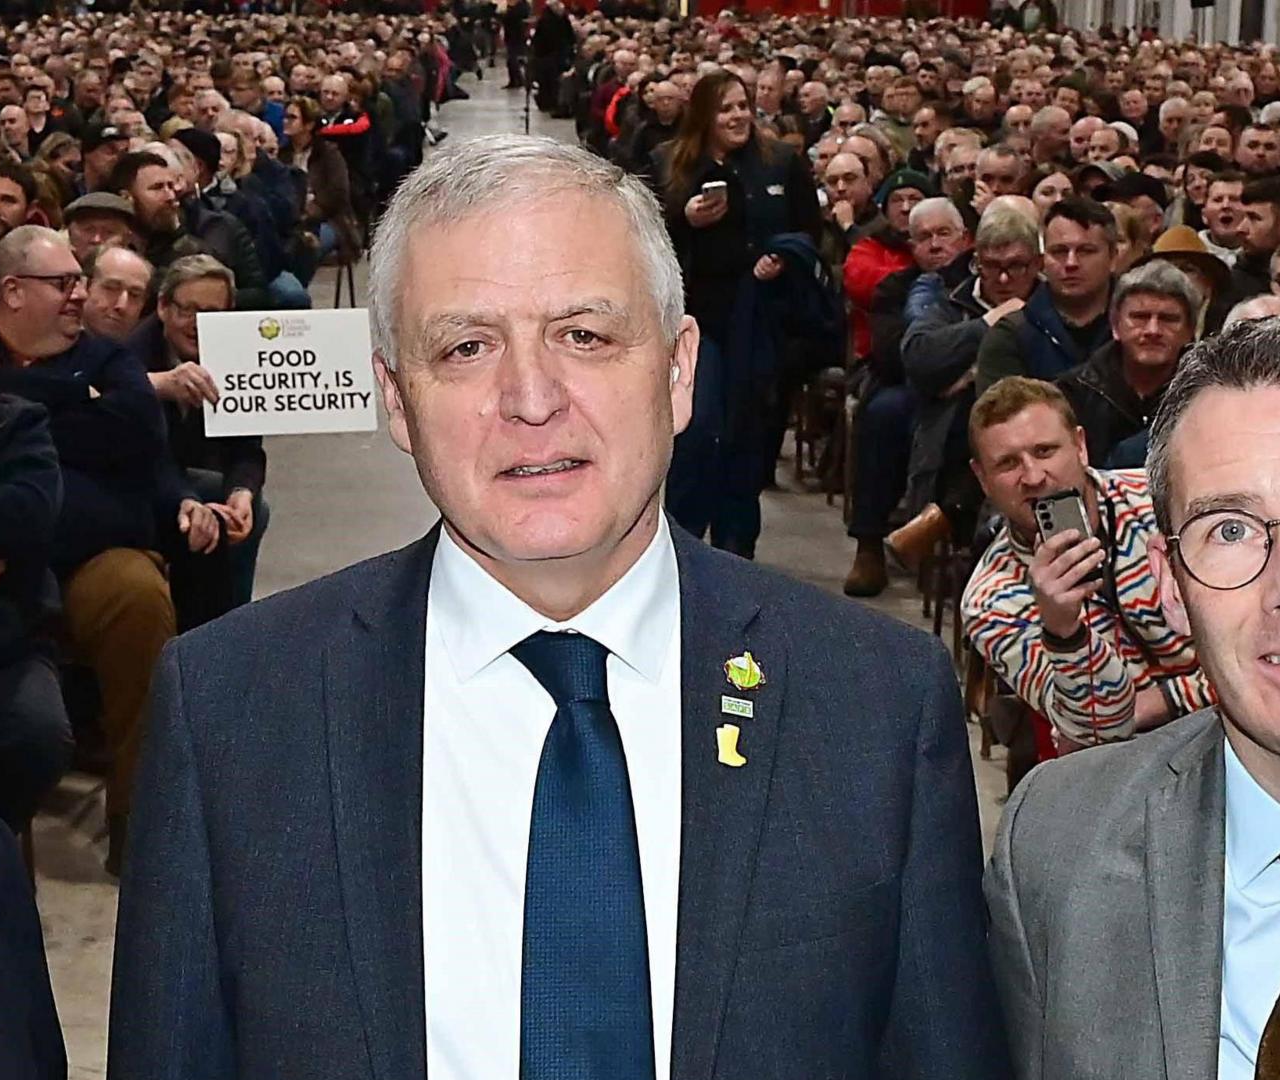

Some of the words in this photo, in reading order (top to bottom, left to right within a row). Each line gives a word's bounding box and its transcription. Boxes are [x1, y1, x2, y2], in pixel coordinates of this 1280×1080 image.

[258, 350, 316, 368] FOOD
[224, 372, 329, 391] SECURITY,
[335, 371, 353, 388] IS
[274, 392, 371, 412] SECURITY
